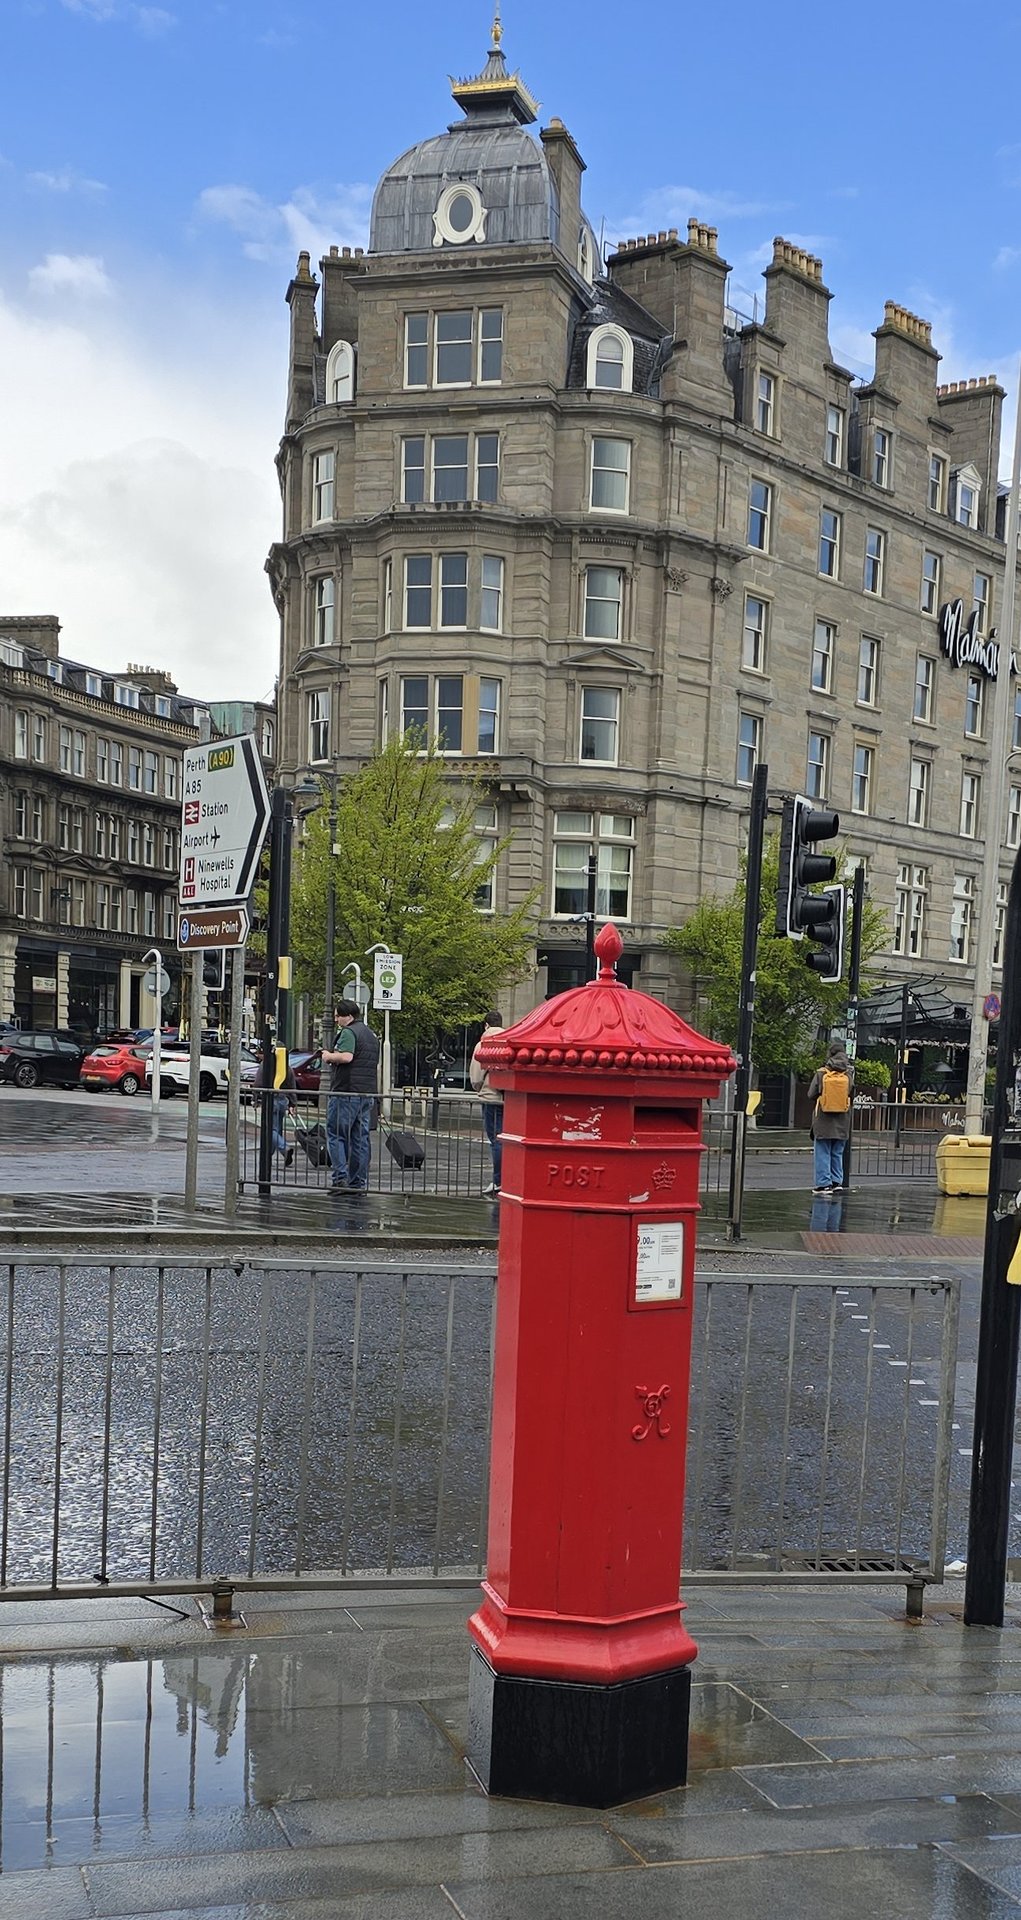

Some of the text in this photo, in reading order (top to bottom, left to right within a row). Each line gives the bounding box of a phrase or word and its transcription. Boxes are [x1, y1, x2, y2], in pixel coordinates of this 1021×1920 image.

[940, 598, 1021, 678] Malmain
[186, 747, 234, 773] Perth (A90)
[201, 802, 229, 818] Station
[183, 832, 209, 849] Airport
[198, 855, 235, 874] Ninewells
[200, 876, 231, 893] Hospital
[190, 919, 240, 938] Discovery Point
[381, 976, 395, 984] LEZ
[547, 1164, 606, 1189] POST
